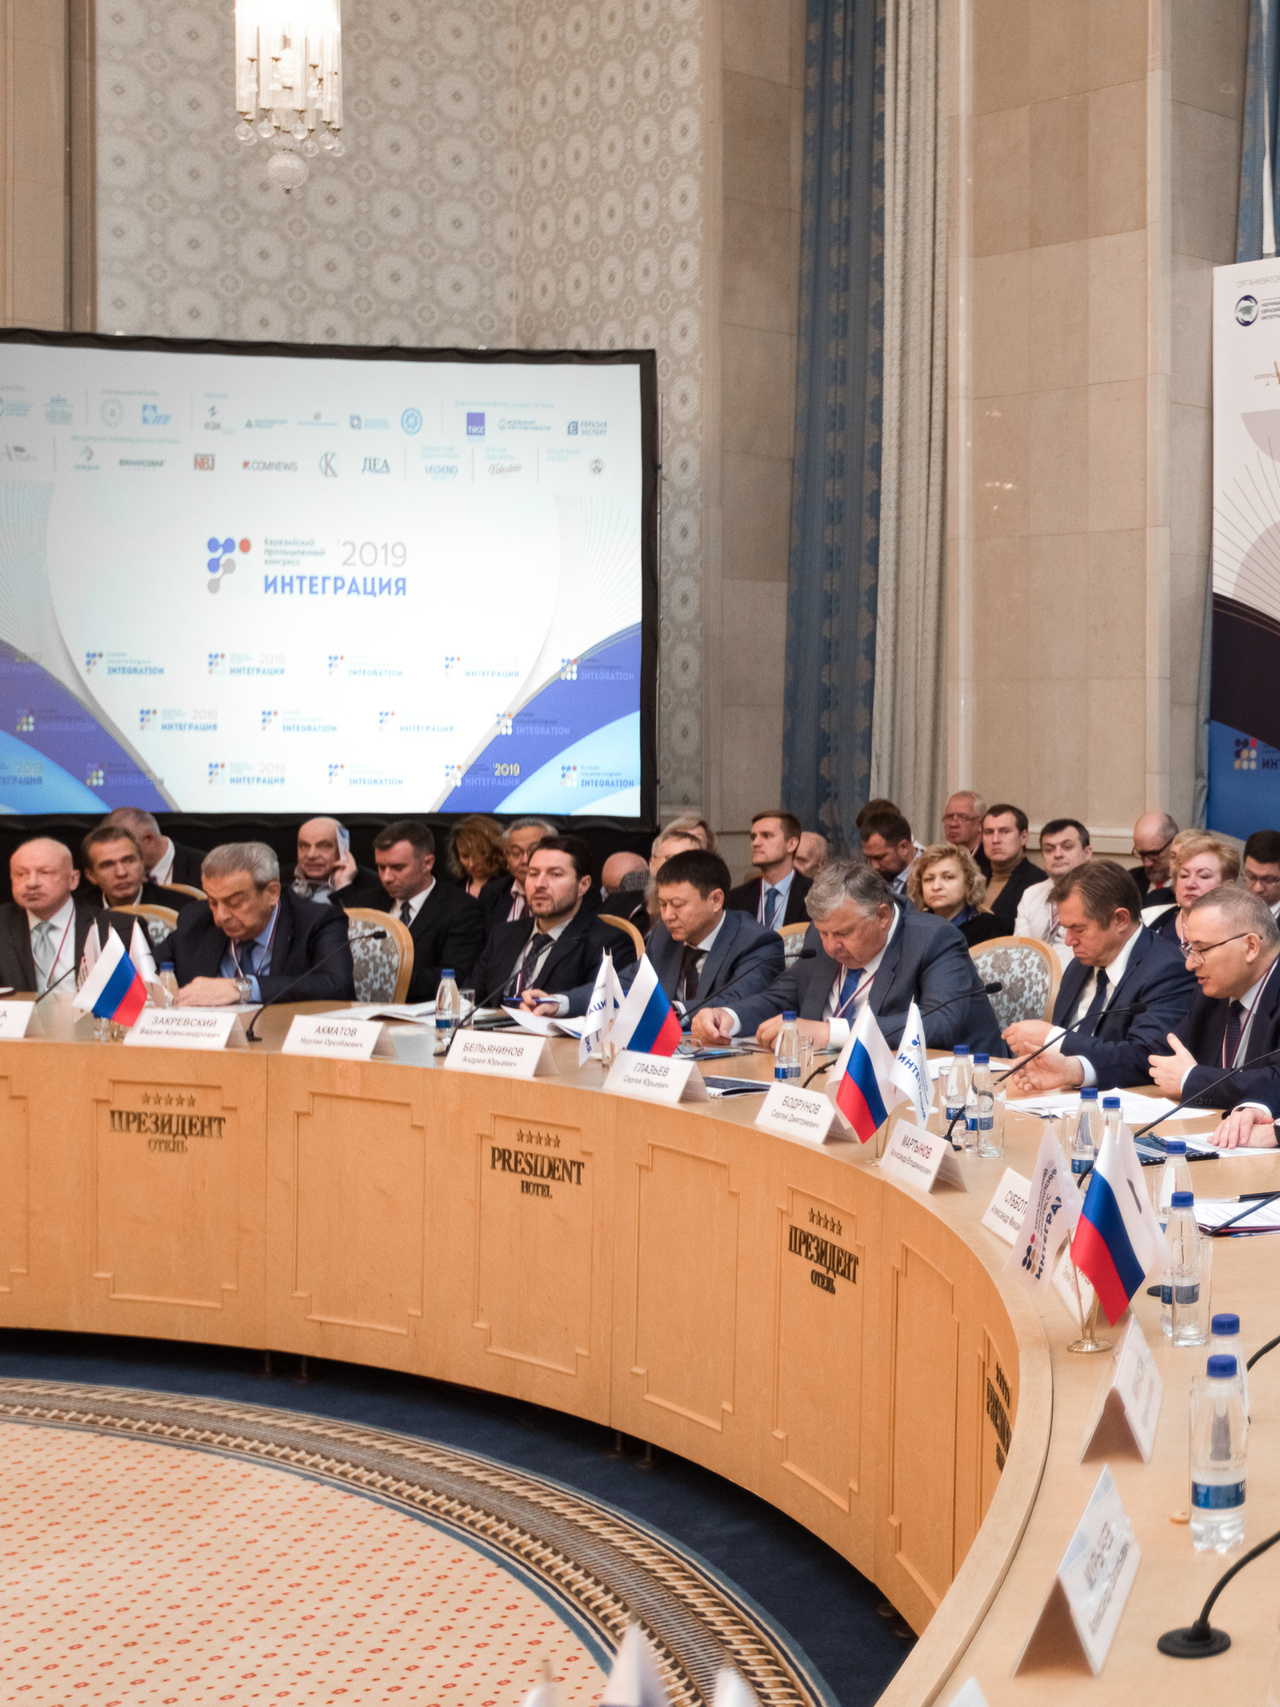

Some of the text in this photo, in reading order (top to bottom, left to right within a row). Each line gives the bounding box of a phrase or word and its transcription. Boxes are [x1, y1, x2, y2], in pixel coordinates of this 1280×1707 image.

[194, 455, 215, 471] NBJ
[251, 461, 298, 472] COMNEWS
[263, 575, 407, 598] ИНТЕГРАЦИЯ
[151, 1016, 218, 1028] ЗАКРЕВСКИЙ
[315, 1026, 358, 1037] АКМАТОВ
[463, 1042, 524, 1057] БЕЛЬЯНИНОВ
[462, 1056, 486, 1065] Андрей
[633, 1062, 670, 1077] ГЛАЗЬЕВ
[623, 1074, 641, 1085] Сергей
[782, 1095, 821, 1115] БОДРУНОВ
[110, 1109, 227, 1140] ПРЕЗИДЕНТ
[147, 1138, 188, 1154] ОТЕЛЬ
[901, 1134, 933, 1159] МАРТЫНОВ
[489, 1146, 586, 1186] PRESIDENT
[520, 1180, 553, 1199] HOTEL
[788, 1223, 860, 1284] ПРЕЗИДЕНТ
[810, 1269, 836, 1296] ОТЕЛЬ
